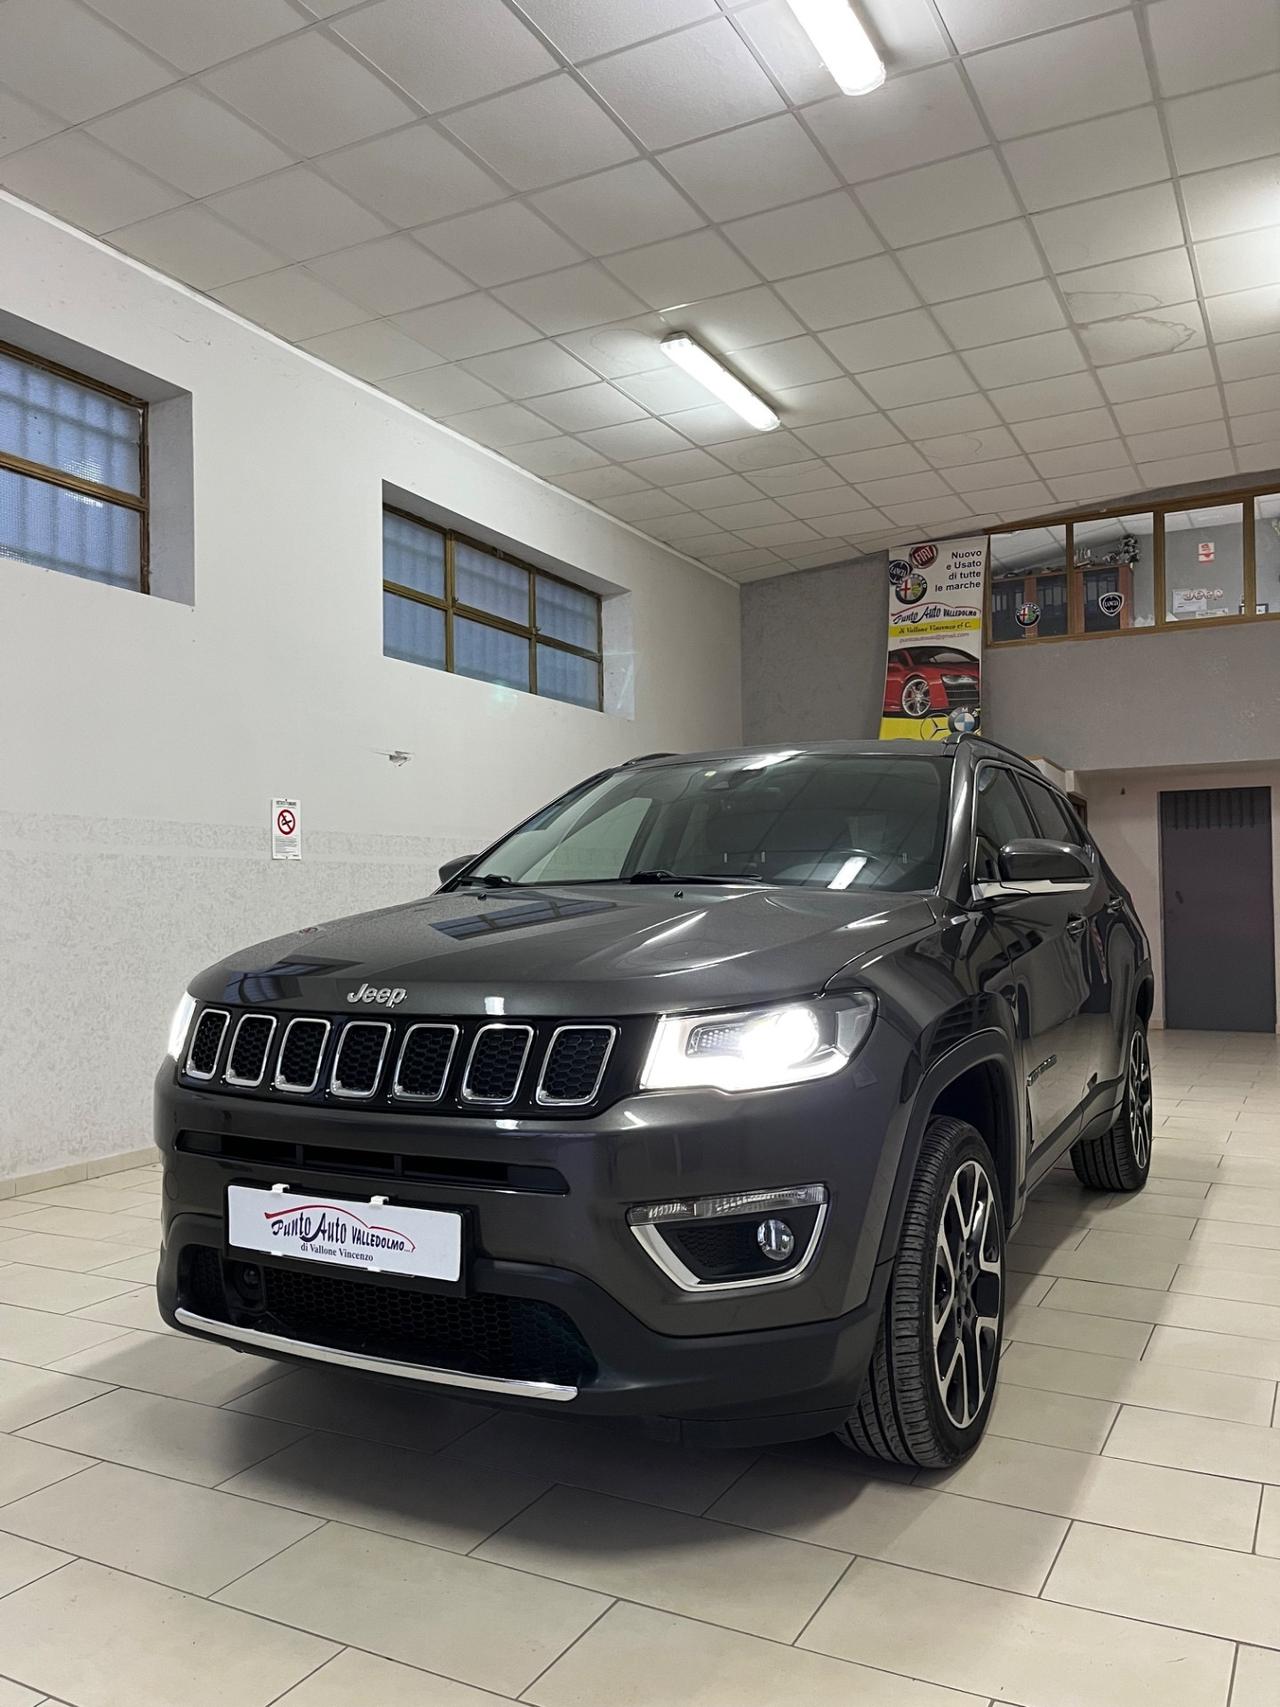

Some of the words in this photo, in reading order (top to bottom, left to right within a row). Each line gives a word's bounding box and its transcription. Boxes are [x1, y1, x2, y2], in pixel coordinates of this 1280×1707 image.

[914, 547, 933, 563] FIAT
[951, 550, 982, 559] Nuovo
[954, 560, 982, 569] Usato
[948, 572, 957, 581] di
[959, 570, 981, 579] tutte
[935, 584, 943, 592] le
[945, 581, 981, 591] marche
[1183, 589, 1224, 601] Jeep
[893, 611, 919, 624] Punto
[911, 606, 941, 623] Auto
[943, 608, 977, 617] VALLEDOLMO
[906, 625, 928, 634] Vallone
[929, 623, 956, 632] Vincenzo
[346, 983, 407, 1008] Jeep
[271, 1212, 312, 1237] Punto
[299, 1212, 347, 1245] Auto
[351, 1225, 405, 1251] VALLEDOLMO
[300, 1243, 309, 1252] di
[309, 1244, 337, 1257] Vallone
[338, 1248, 374, 1262] Vincenzo
